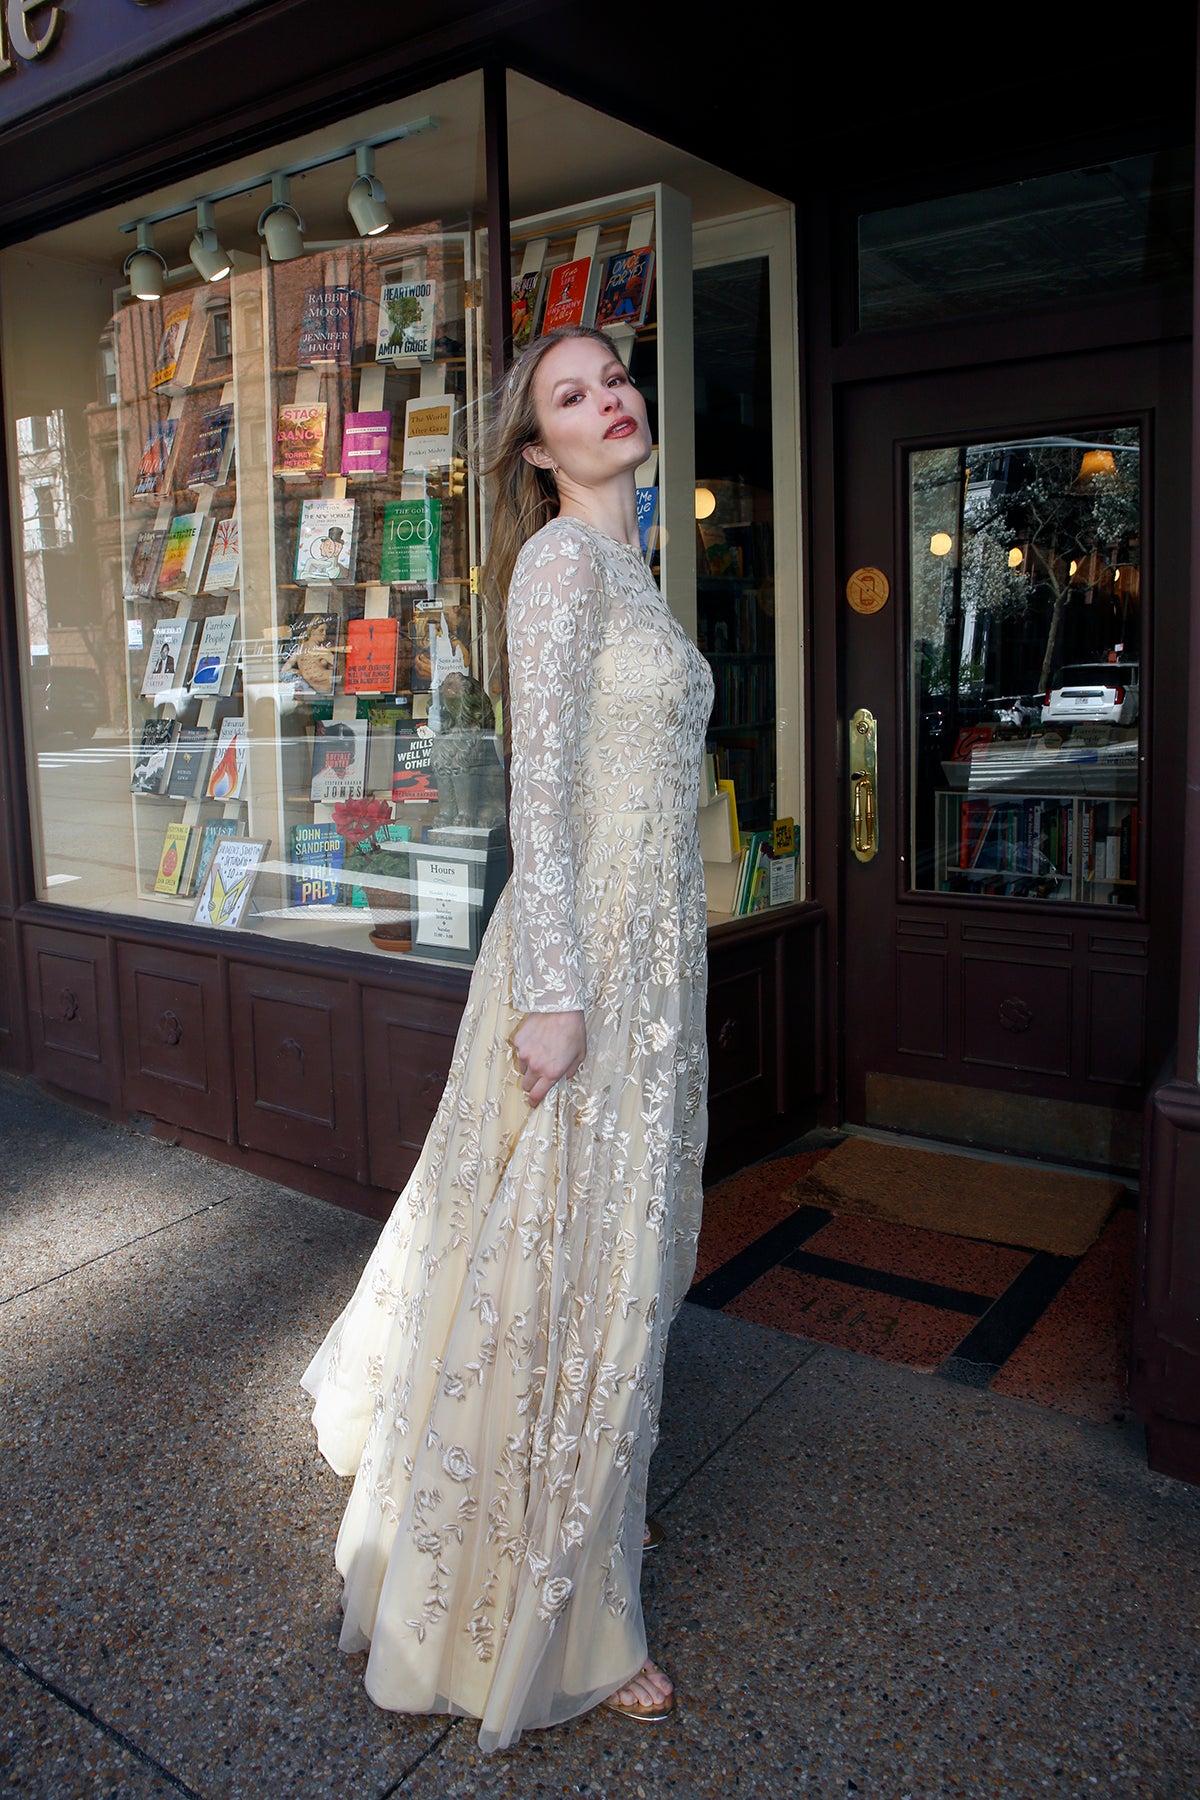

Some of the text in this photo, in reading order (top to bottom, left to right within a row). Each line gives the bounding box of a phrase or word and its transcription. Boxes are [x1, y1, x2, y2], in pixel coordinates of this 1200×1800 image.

[308, 292, 350, 304] RABBIT
[384, 284, 431, 300] HEARTWOOD
[308, 306, 349, 318] MOON
[303, 331, 349, 342] JENNIFER
[308, 342, 341, 352] HAIGH
[378, 339, 429, 356] AMITY GAIGE
[284, 408, 318, 420] STAG
[411, 413, 447, 423] The World
[277, 430, 323, 442] DANCE
[410, 425, 447, 435] After Gaza
[390, 519, 433, 541] 100
[206, 620, 231, 630] Careless
[205, 633, 225, 645] People
[410, 739, 433, 751] KILLS
[397, 751, 421, 762] WELL
[324, 786, 362, 798] JONES
[205, 826, 233, 836] TWIST
[295, 828, 321, 842] JOHN
[295, 839, 340, 855] SANDFORD
[227, 868, 236, 879] 10
[431, 864, 455, 874] Hours
[302, 877, 338, 904] PREY
